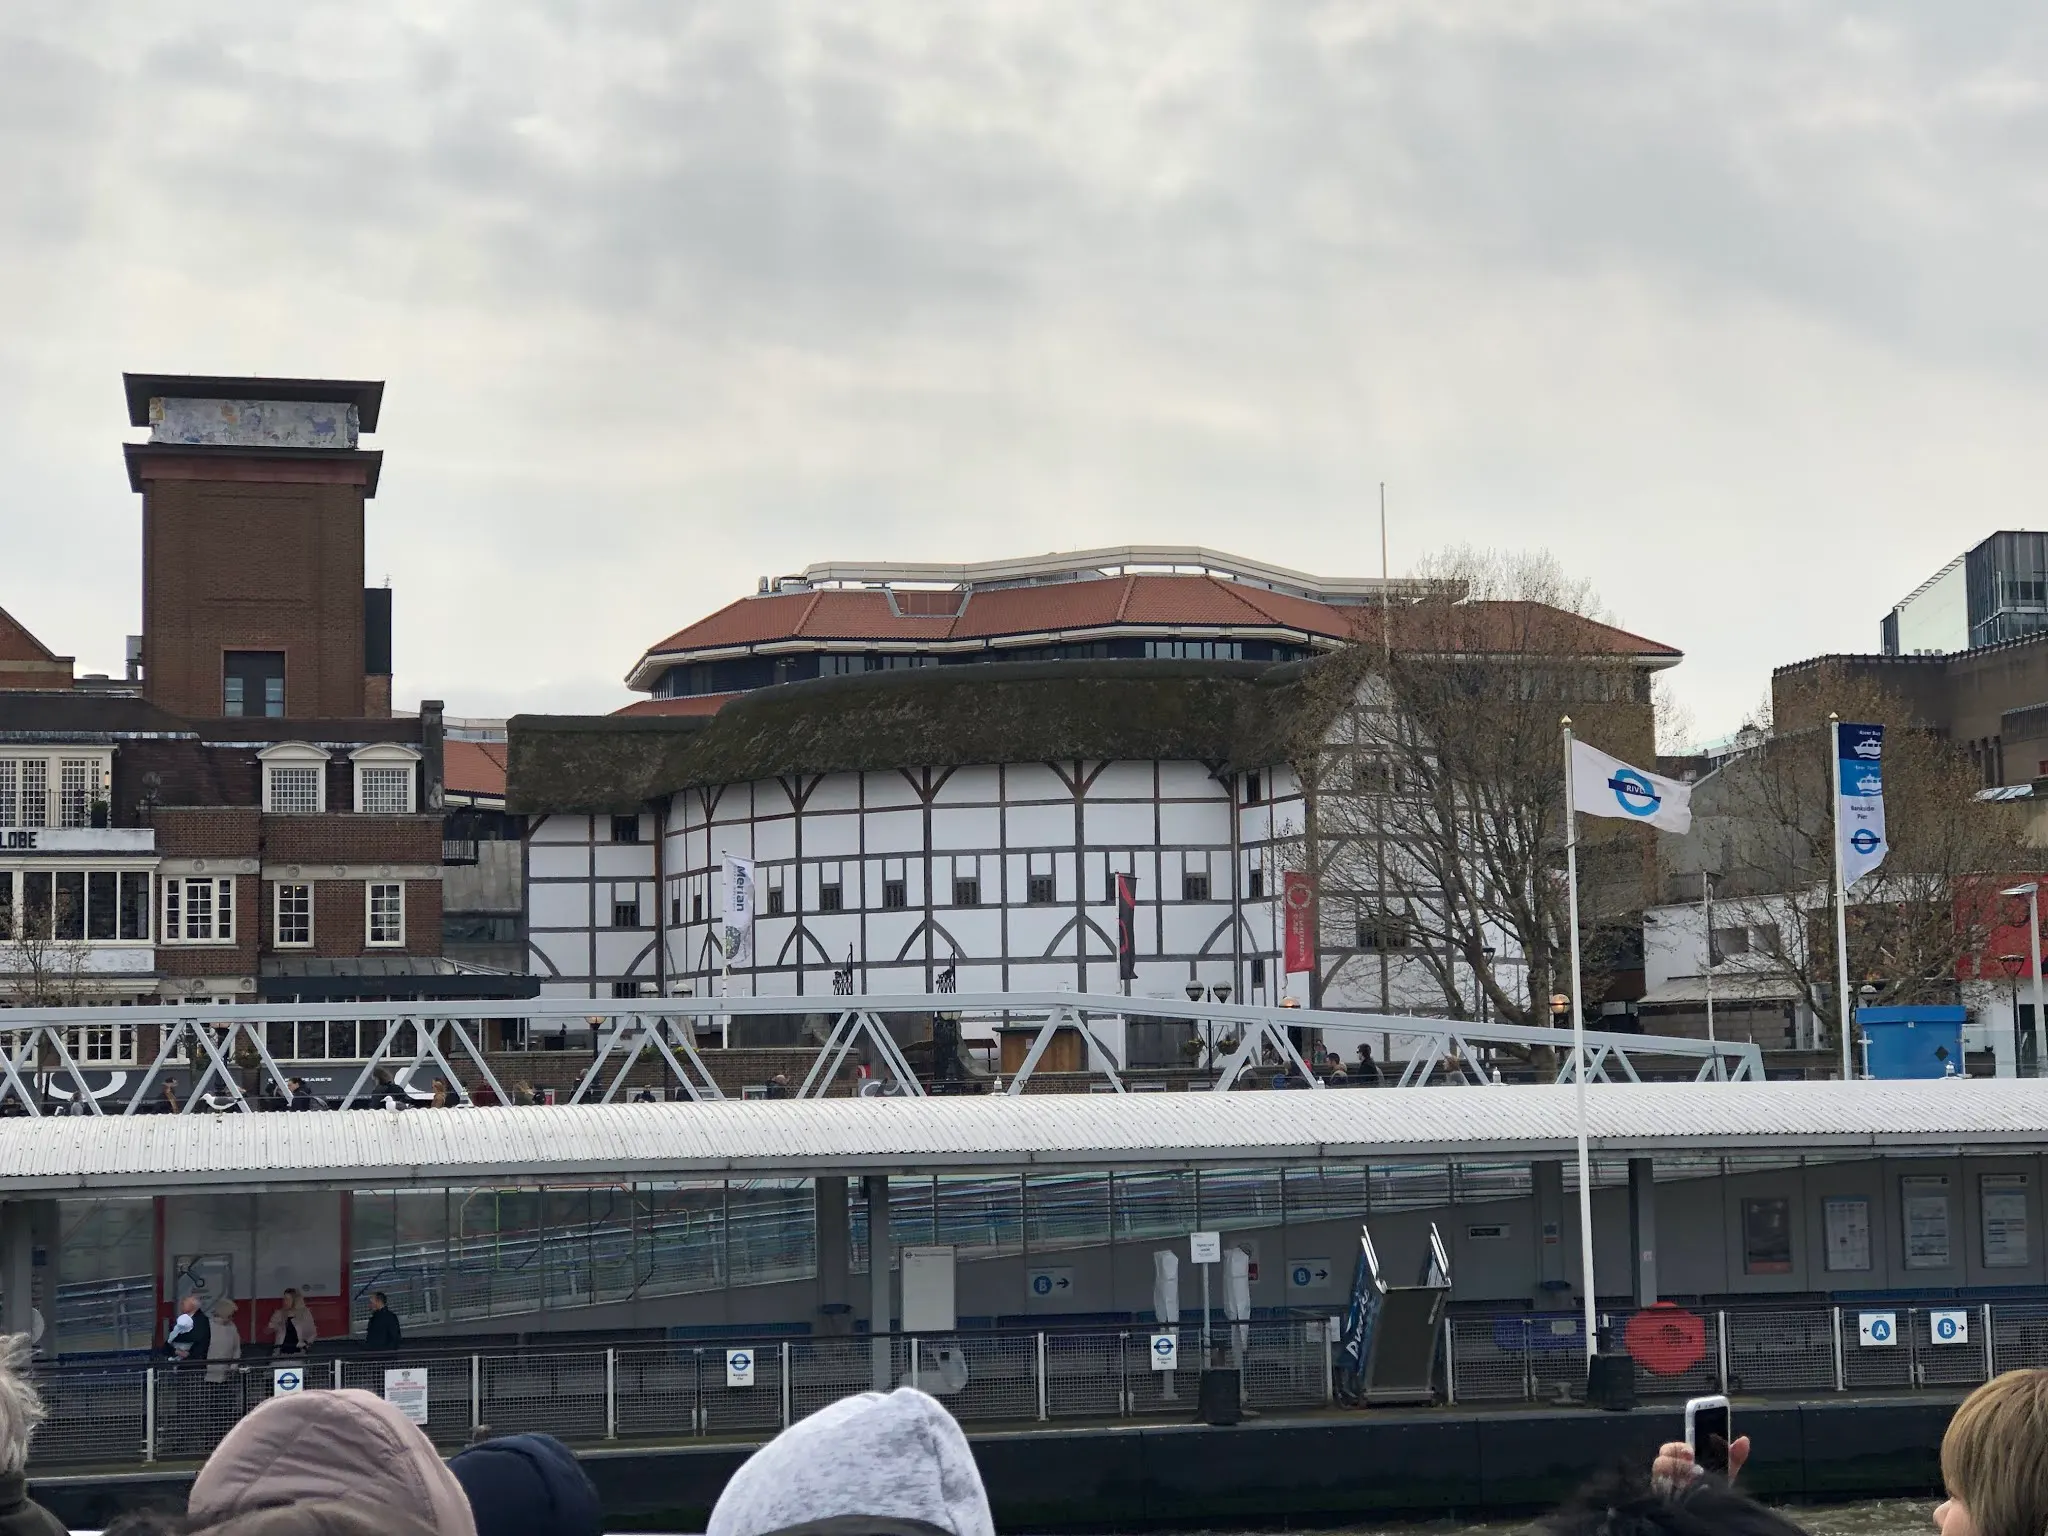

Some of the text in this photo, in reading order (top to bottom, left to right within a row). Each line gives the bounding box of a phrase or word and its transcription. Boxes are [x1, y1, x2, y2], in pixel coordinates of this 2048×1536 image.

[1626, 785, 1646, 794] RIVE
[736, 865, 746, 911] Merian
[1299, 1270, 1307, 1282] B
[1039, 1279, 1048, 1291] B
[1875, 1324, 1887, 1337] A
[1943, 1322, 1953, 1335] B
